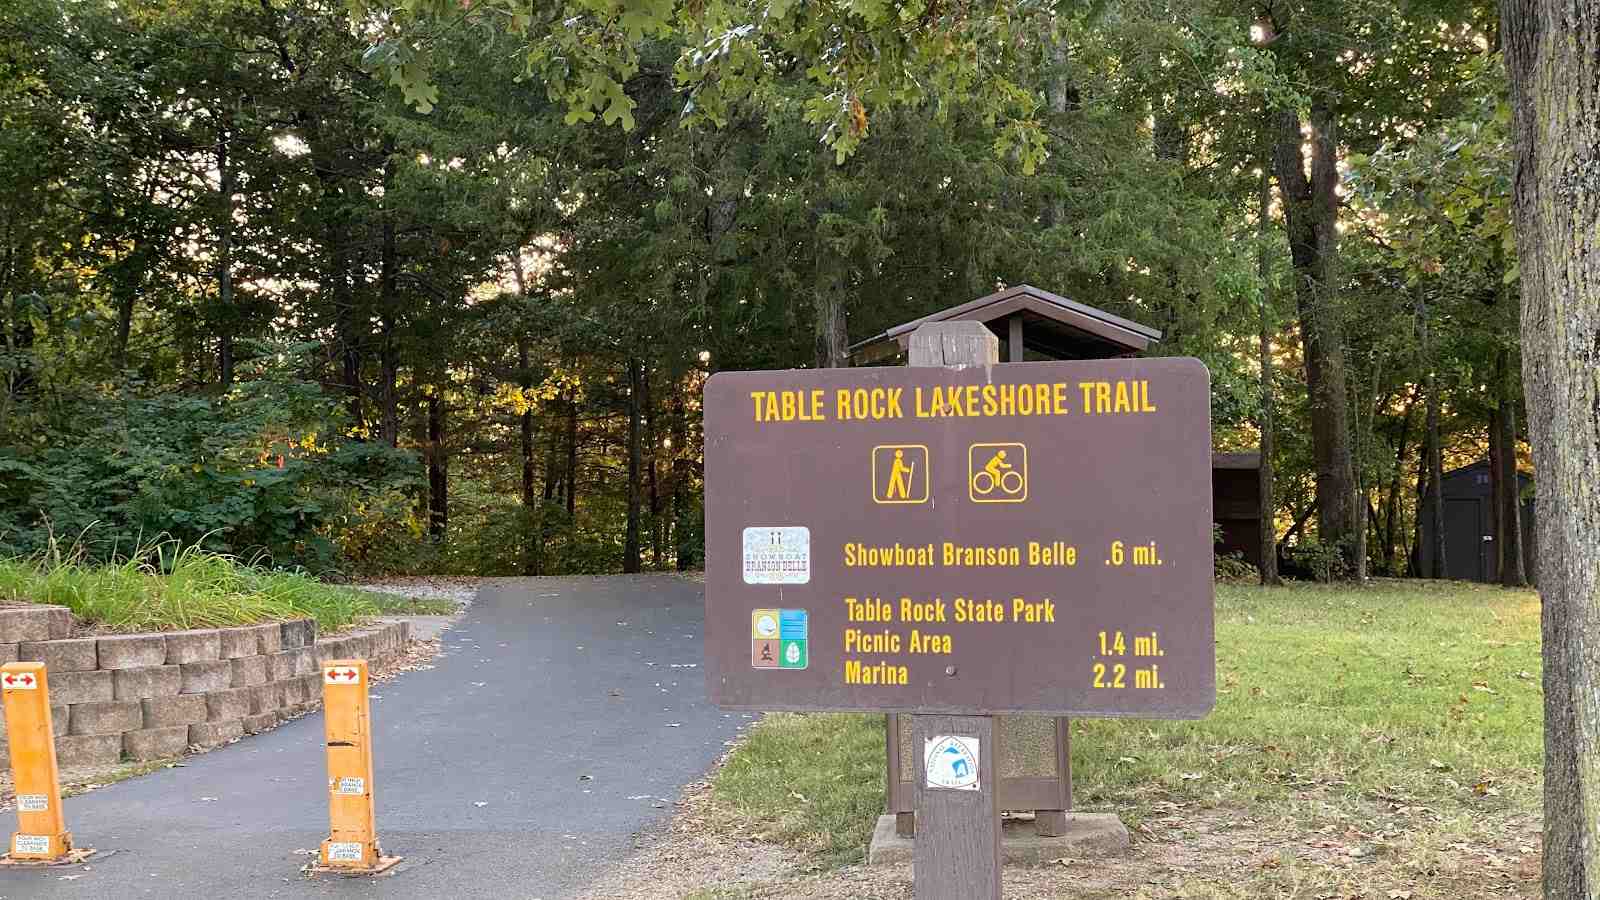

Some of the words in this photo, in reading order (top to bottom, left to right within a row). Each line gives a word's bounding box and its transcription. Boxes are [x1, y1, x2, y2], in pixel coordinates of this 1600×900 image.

[752, 389, 826, 423] TABLE
[836, 385, 904, 421] ROCK
[914, 381, 1068, 419] LAKESHORE
[1079, 379, 1157, 416] TRAIL
[843, 541, 935, 569] Showboat
[941, 541, 1021, 568] Branson
[1028, 541, 1078, 567] Belle
[1104, 541, 1125, 567] .6
[1132, 541, 1163, 566] mi.
[845, 596, 893, 623] Table
[899, 597, 946, 624] Rock
[953, 597, 1005, 624] State
[1011, 597, 1056, 624] Park
[844, 629, 902, 655] Picnic
[908, 629, 953, 655] Area
[1098, 631, 1126, 657] 1.4
[1133, 632, 1165, 658] mi.
[844, 660, 909, 687] Marina
[1092, 663, 1126, 690] 2.2
[1134, 663, 1166, 690] mi.
